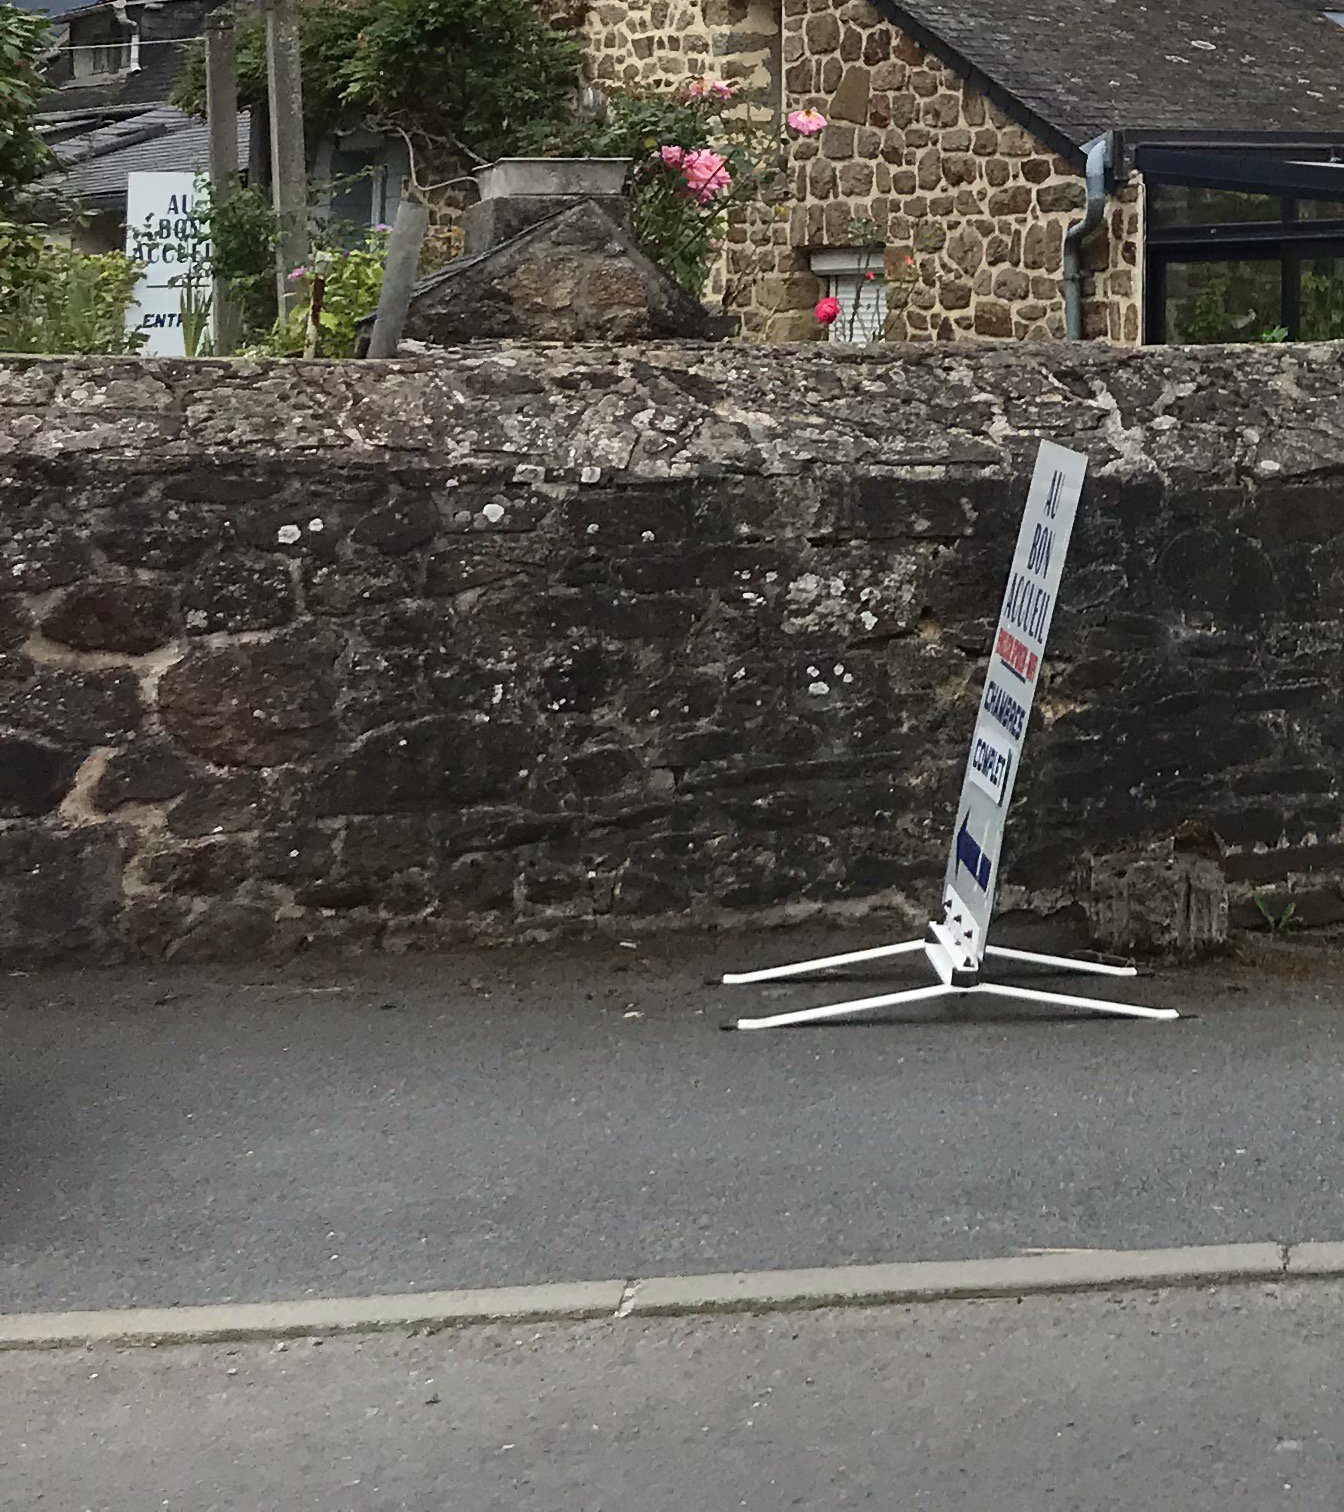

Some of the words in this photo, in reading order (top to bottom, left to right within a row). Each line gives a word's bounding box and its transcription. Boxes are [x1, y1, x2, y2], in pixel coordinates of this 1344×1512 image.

[159, 218, 200, 240] BON
[167, 194, 193, 215] AU
[133, 242, 210, 264] ACCUEI
[143, 313, 183, 328] ENTR
[1043, 469, 1066, 520] AU
[1027, 522, 1056, 580] BON
[1003, 572, 1051, 645] ACCUEIL
[984, 680, 1026, 740] CHAMBRES
[972, 738, 1006, 788] COMPLET
